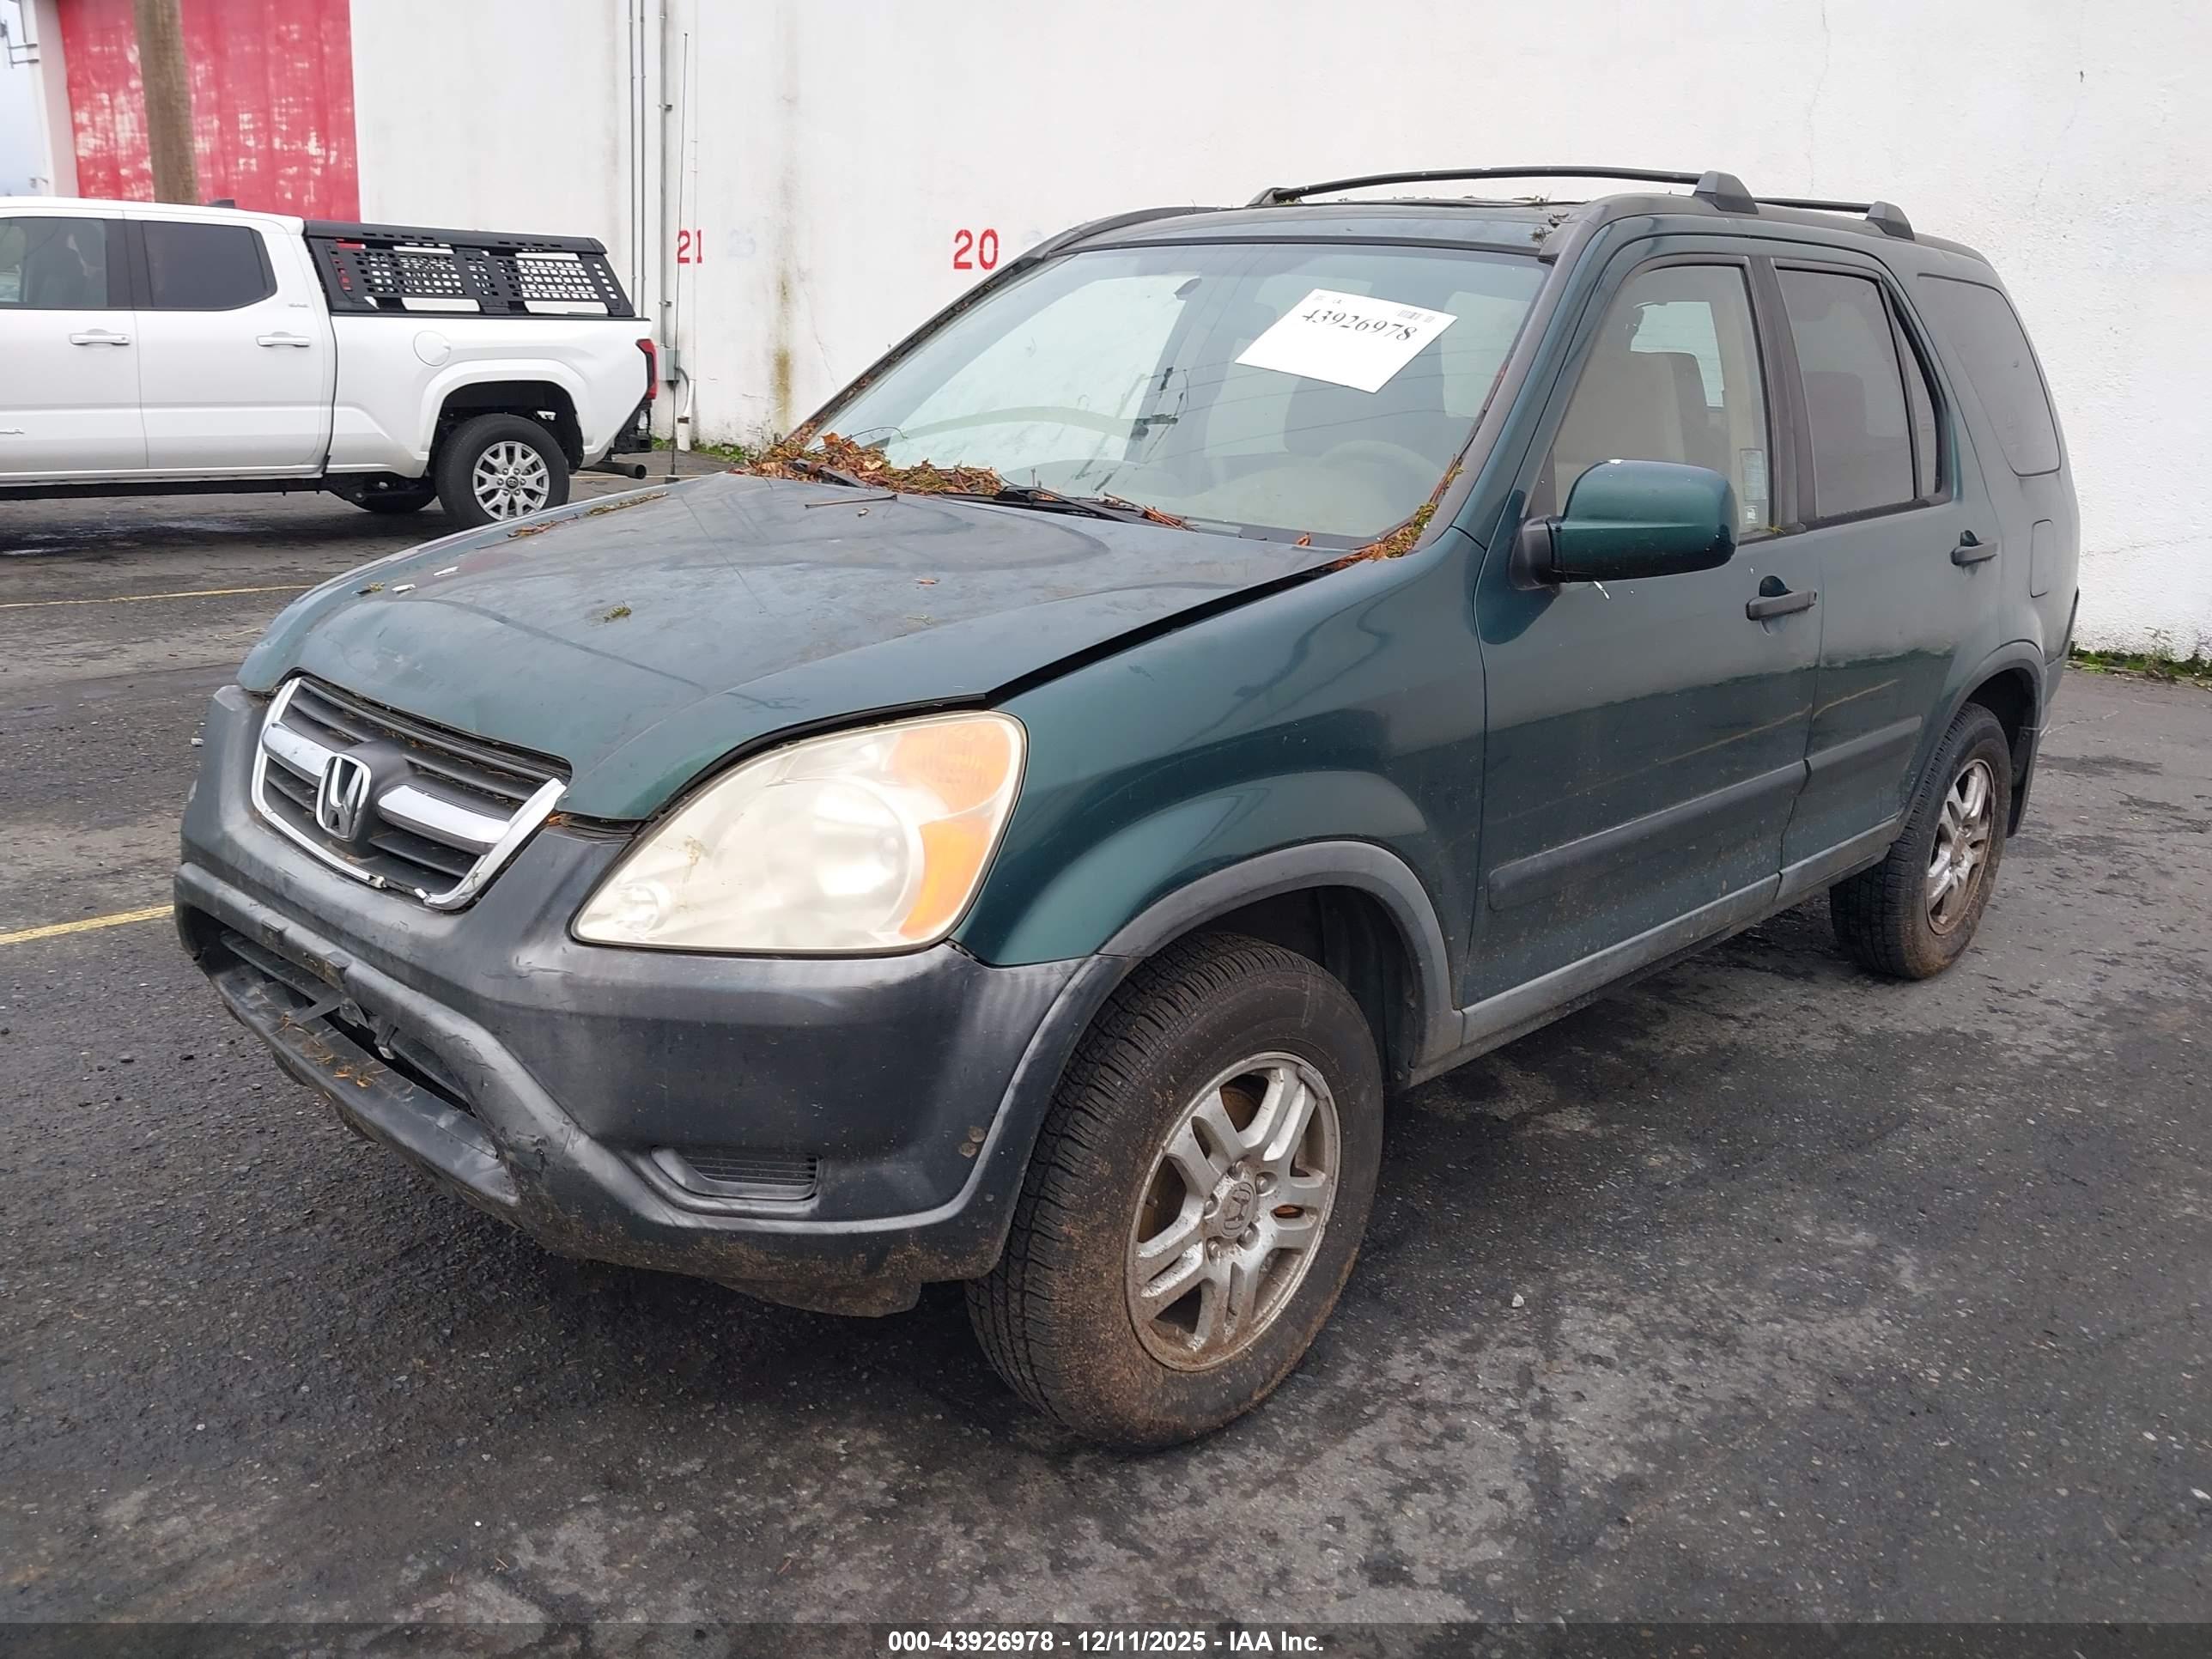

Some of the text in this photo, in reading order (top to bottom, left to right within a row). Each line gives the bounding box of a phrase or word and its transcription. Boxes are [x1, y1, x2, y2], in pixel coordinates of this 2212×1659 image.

[677, 229, 703, 264] 21
[952, 228, 1000, 270] 20
[1302, 309, 1418, 341] 43926978
